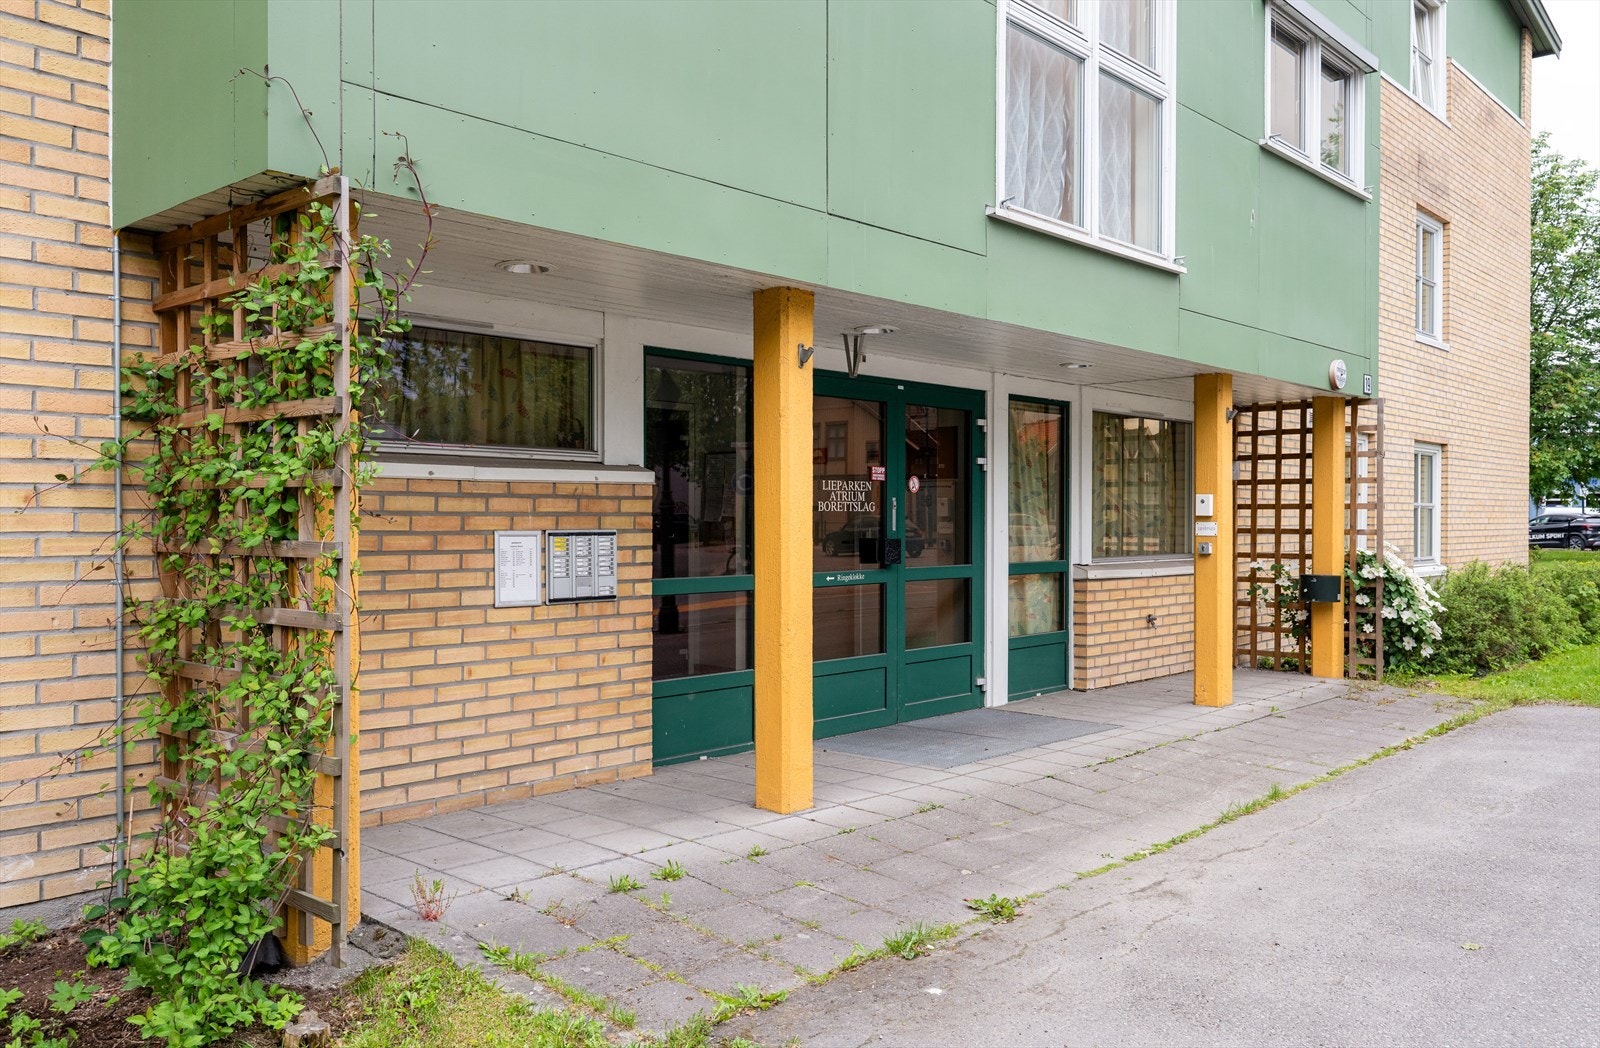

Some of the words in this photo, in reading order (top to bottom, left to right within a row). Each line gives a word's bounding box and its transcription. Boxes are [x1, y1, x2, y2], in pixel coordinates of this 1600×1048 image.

[1365, 376, 1371, 392] 19
[822, 480, 872, 491] LIEPARKEN
[829, 491, 865, 501] ATRIUM
[818, 501, 876, 512] BORETTSLAG
